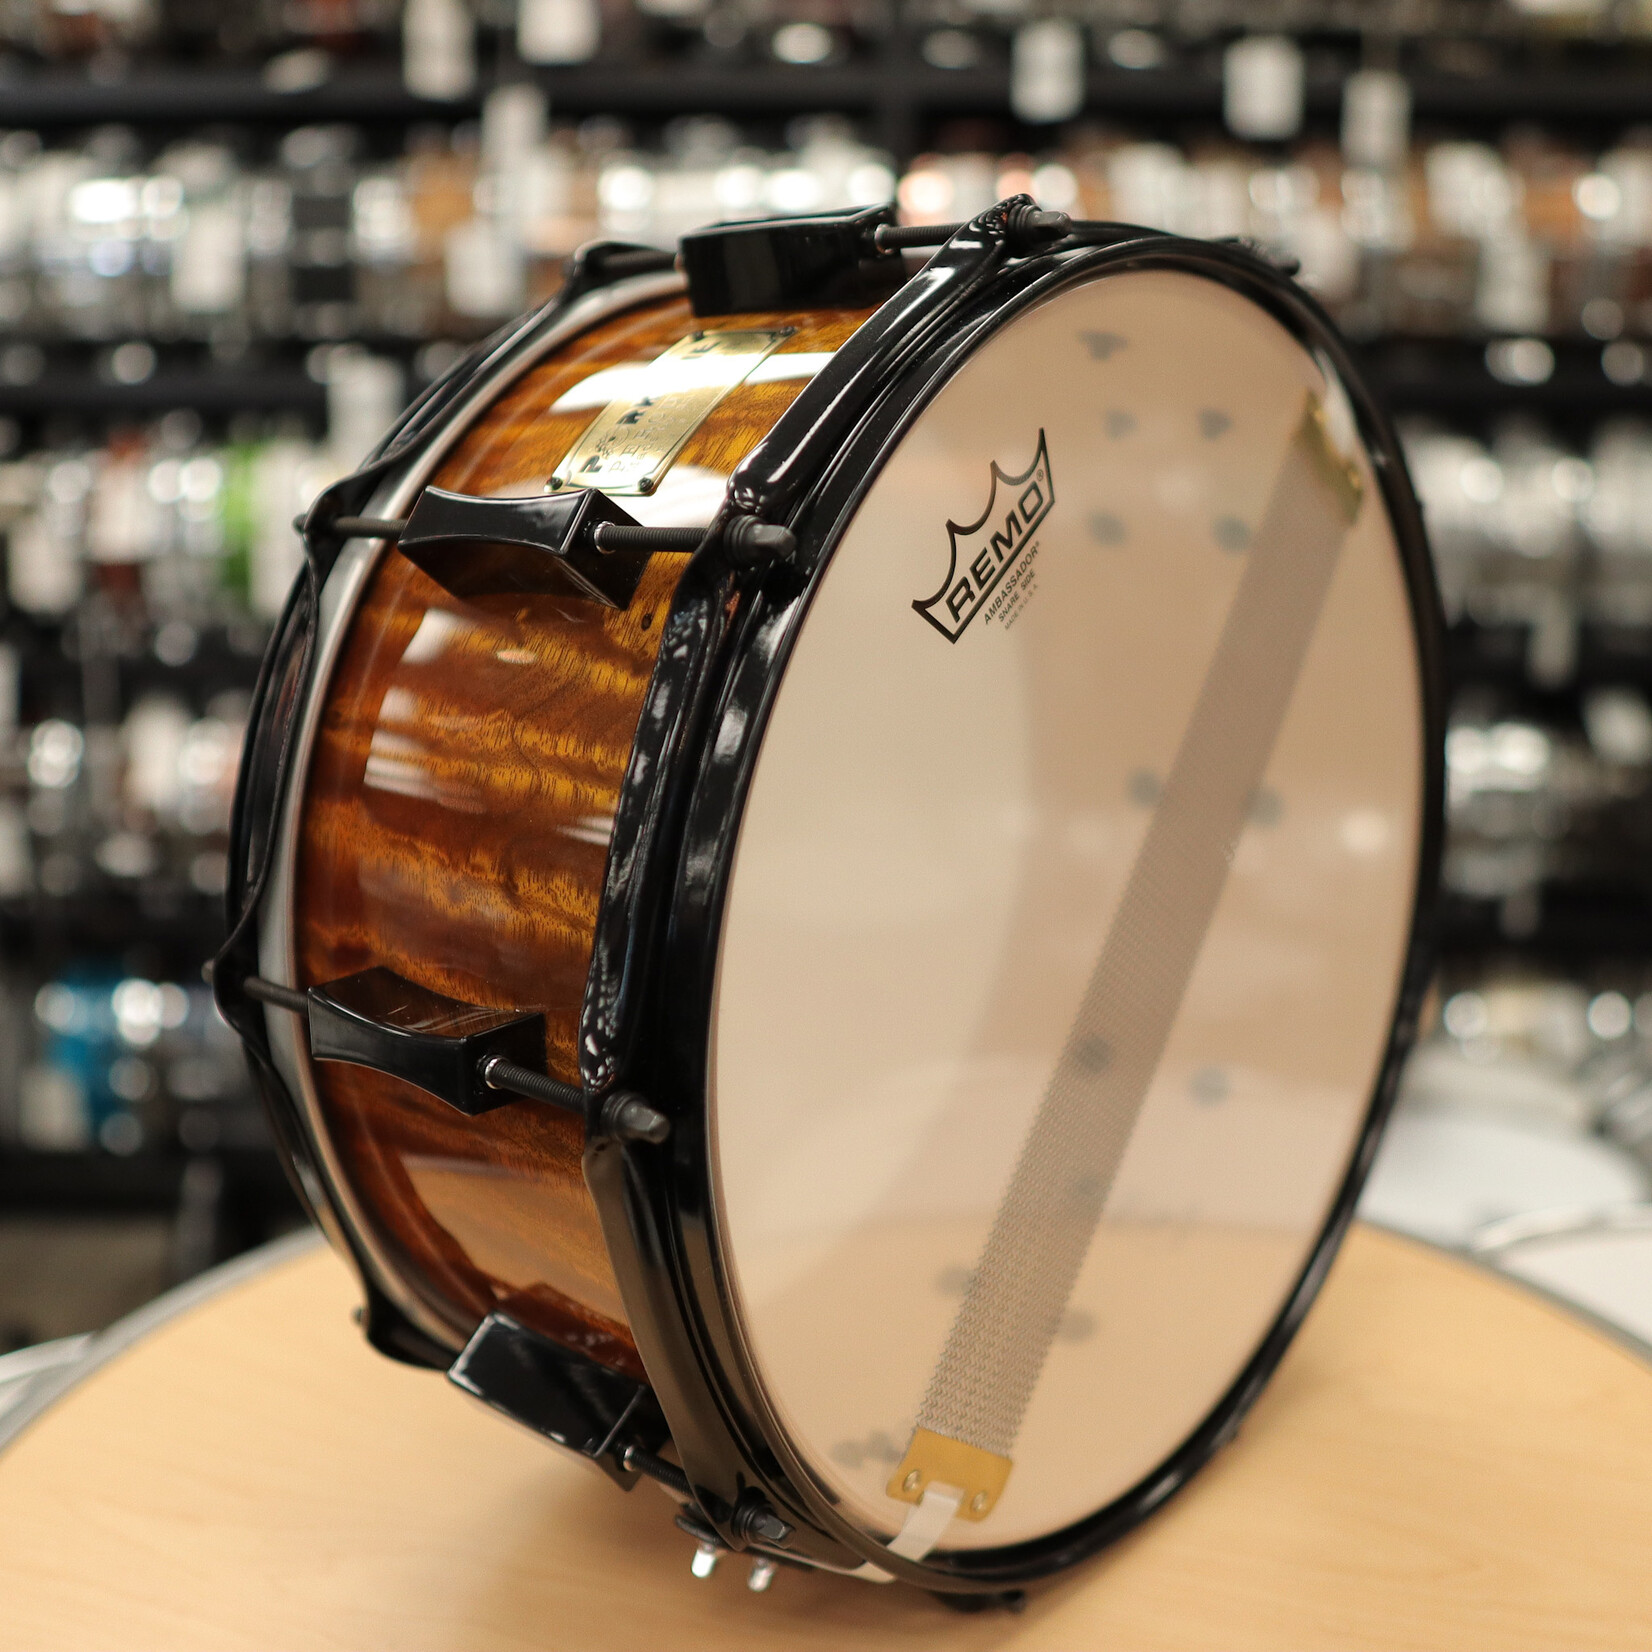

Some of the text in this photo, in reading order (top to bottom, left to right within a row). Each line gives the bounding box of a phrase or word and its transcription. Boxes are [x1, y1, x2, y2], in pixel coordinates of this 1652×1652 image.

[945, 480, 1044, 623] REMO
[984, 545, 1039, 625] AMBASSADOR
[998, 568, 1036, 622] SNARE SIDE
